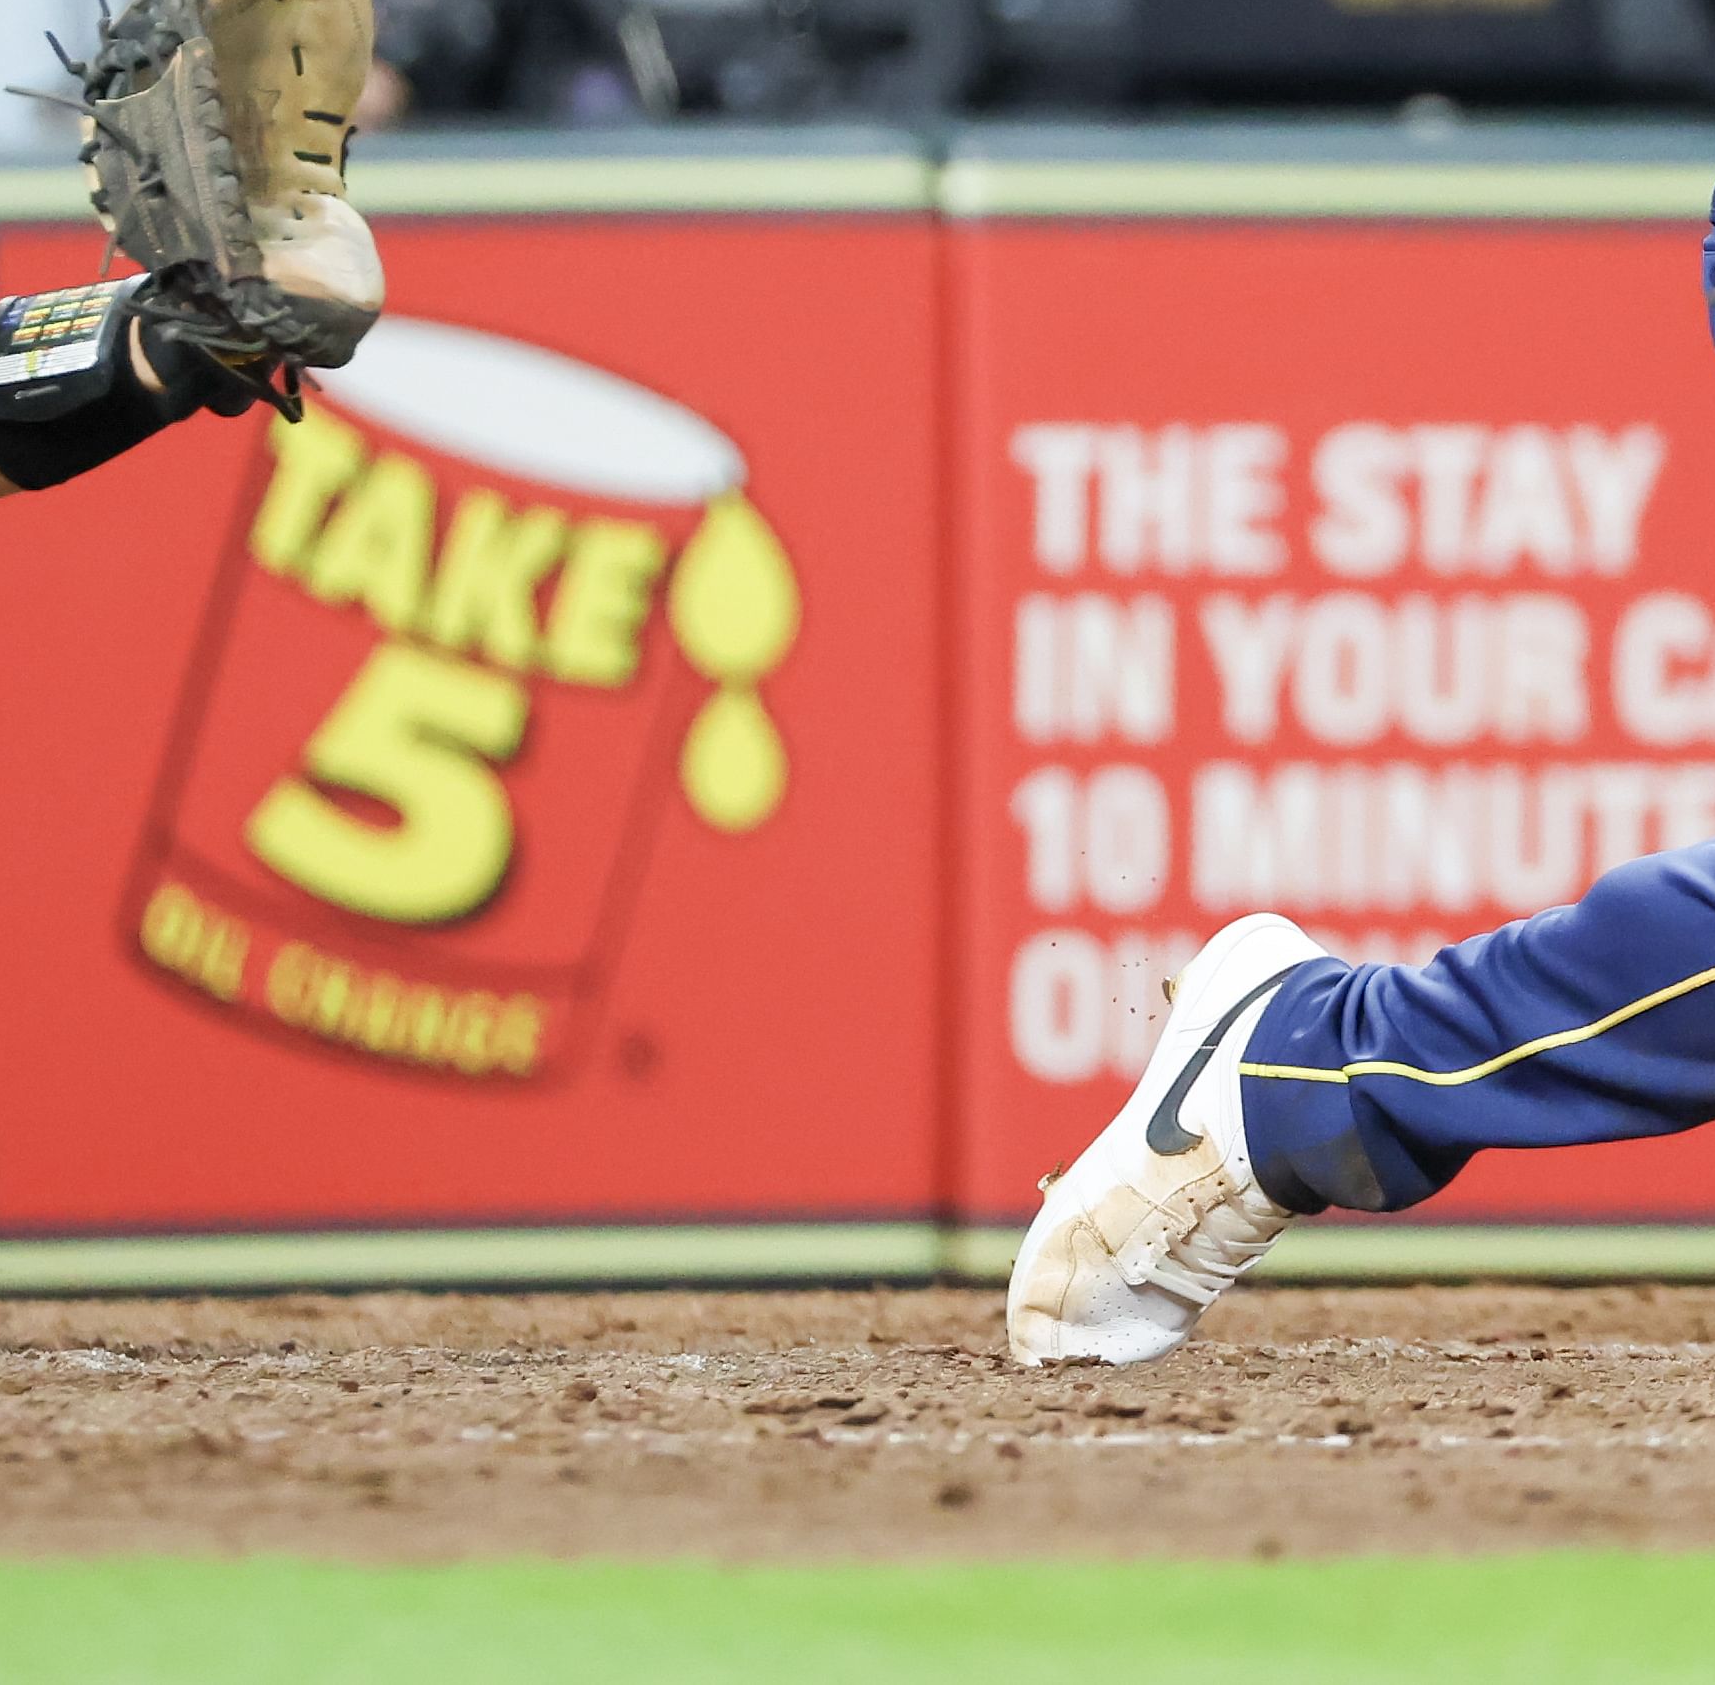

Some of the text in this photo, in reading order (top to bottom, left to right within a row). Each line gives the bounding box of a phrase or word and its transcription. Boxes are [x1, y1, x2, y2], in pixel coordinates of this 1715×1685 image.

[248, 405, 667, 690] TAKE
[1010, 422, 1669, 578] THE STAY
[1014, 592, 1177, 746] IN
[1197, 592, 1593, 746] YOUR
[244, 638, 532, 926] 5
[1009, 764, 1171, 914] 10
[140, 880, 550, 1078] OIL CHANGE
